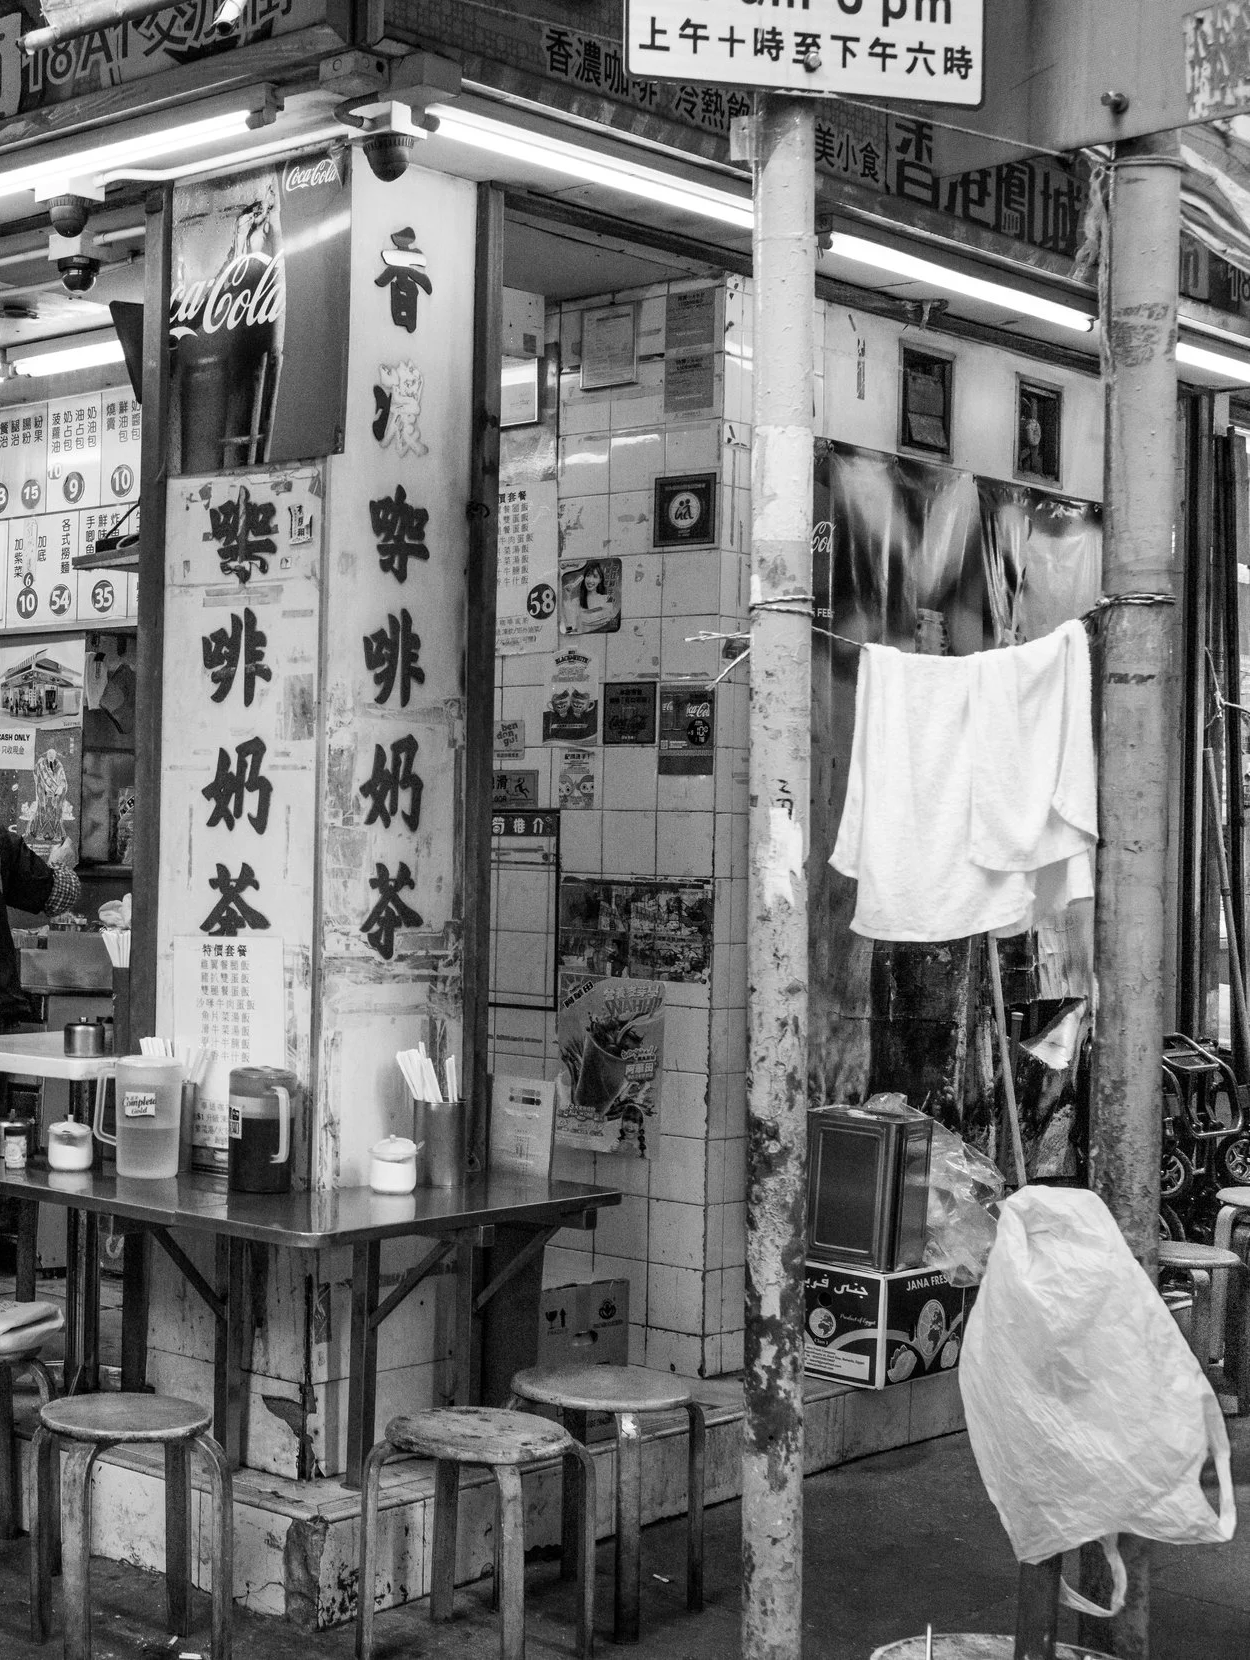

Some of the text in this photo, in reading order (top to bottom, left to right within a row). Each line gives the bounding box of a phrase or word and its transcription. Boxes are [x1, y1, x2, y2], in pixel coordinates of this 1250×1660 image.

[639, 17, 973, 80] 上午十時至下午六時
[286, 159, 339, 192] Coca-Cola
[87, 406, 97, 448] 奶油包
[69, 478, 79, 499] 9
[113, 469, 131, 492] 10
[23, 485, 39, 500] 15
[19, 593, 36, 613] 10
[51, 589, 70, 611] 54
[94, 586, 113, 609] 35
[529, 587, 555, 617] 58
[496, 730, 515, 740] don
[500, 722, 519, 732] ben
[14, 733, 31, 743] ONLY
[202, 943, 248, 957] 特價套餐
[906, 1278, 931, 1292] JANA
